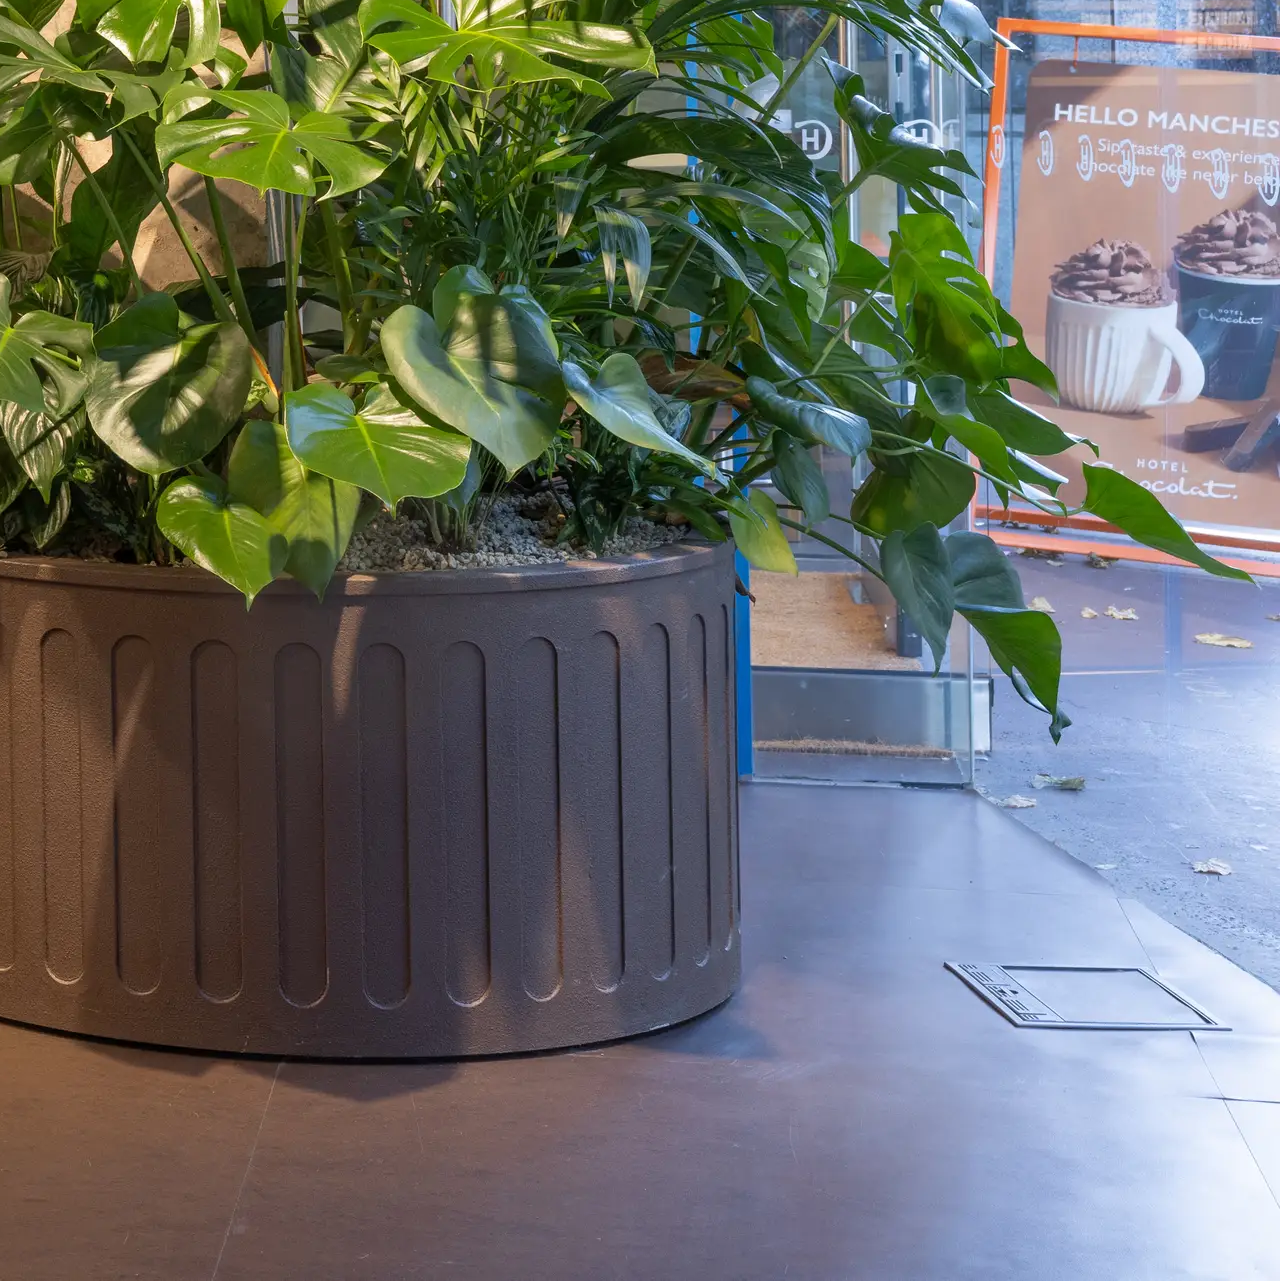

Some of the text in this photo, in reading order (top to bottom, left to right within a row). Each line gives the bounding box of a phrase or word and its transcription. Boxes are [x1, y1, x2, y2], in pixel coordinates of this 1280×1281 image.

[1054, 103, 1280, 138] HELLO MANCHES
[1174, 145, 1186, 158] &
[1218, 308, 1244, 316] HOTEL
[1136, 458, 1188, 474] HOTEL
